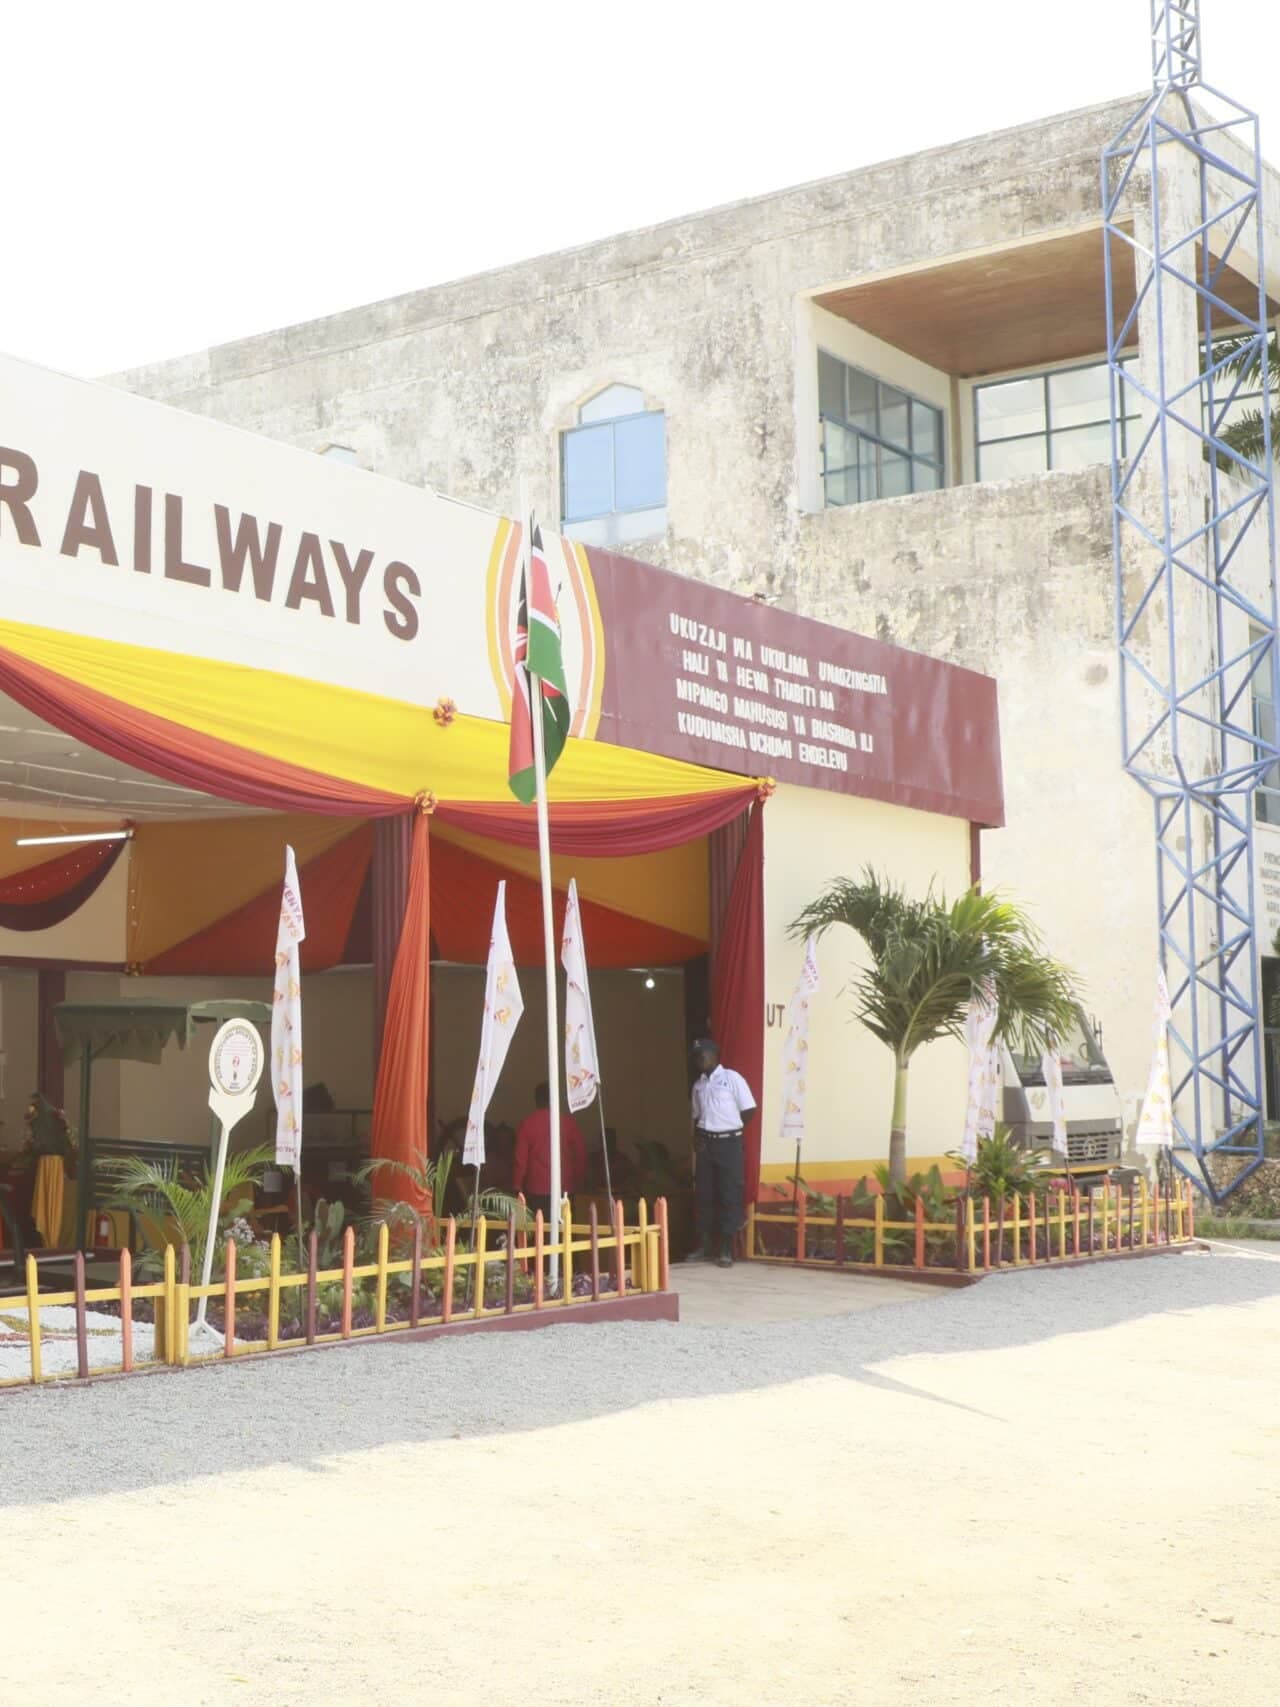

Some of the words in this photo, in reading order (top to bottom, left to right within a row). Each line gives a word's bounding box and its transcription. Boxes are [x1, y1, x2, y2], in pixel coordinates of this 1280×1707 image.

[669, 612, 727, 653] UKUZAJI
[733, 637, 753, 661] WA
[760, 645, 809, 678] UKULIMA
[682, 649, 709, 676] HALI
[716, 659, 729, 682] YA
[736, 665, 769, 694] HEWA
[819, 690, 835, 711] NA
[676, 678, 729, 714] MIPANGO
[733, 696, 788, 731] MAHUSUSI
[792, 715, 806, 736] YA
[860, 733, 873, 753] ILI
[677, 711, 748, 749] KUDUMISHA
